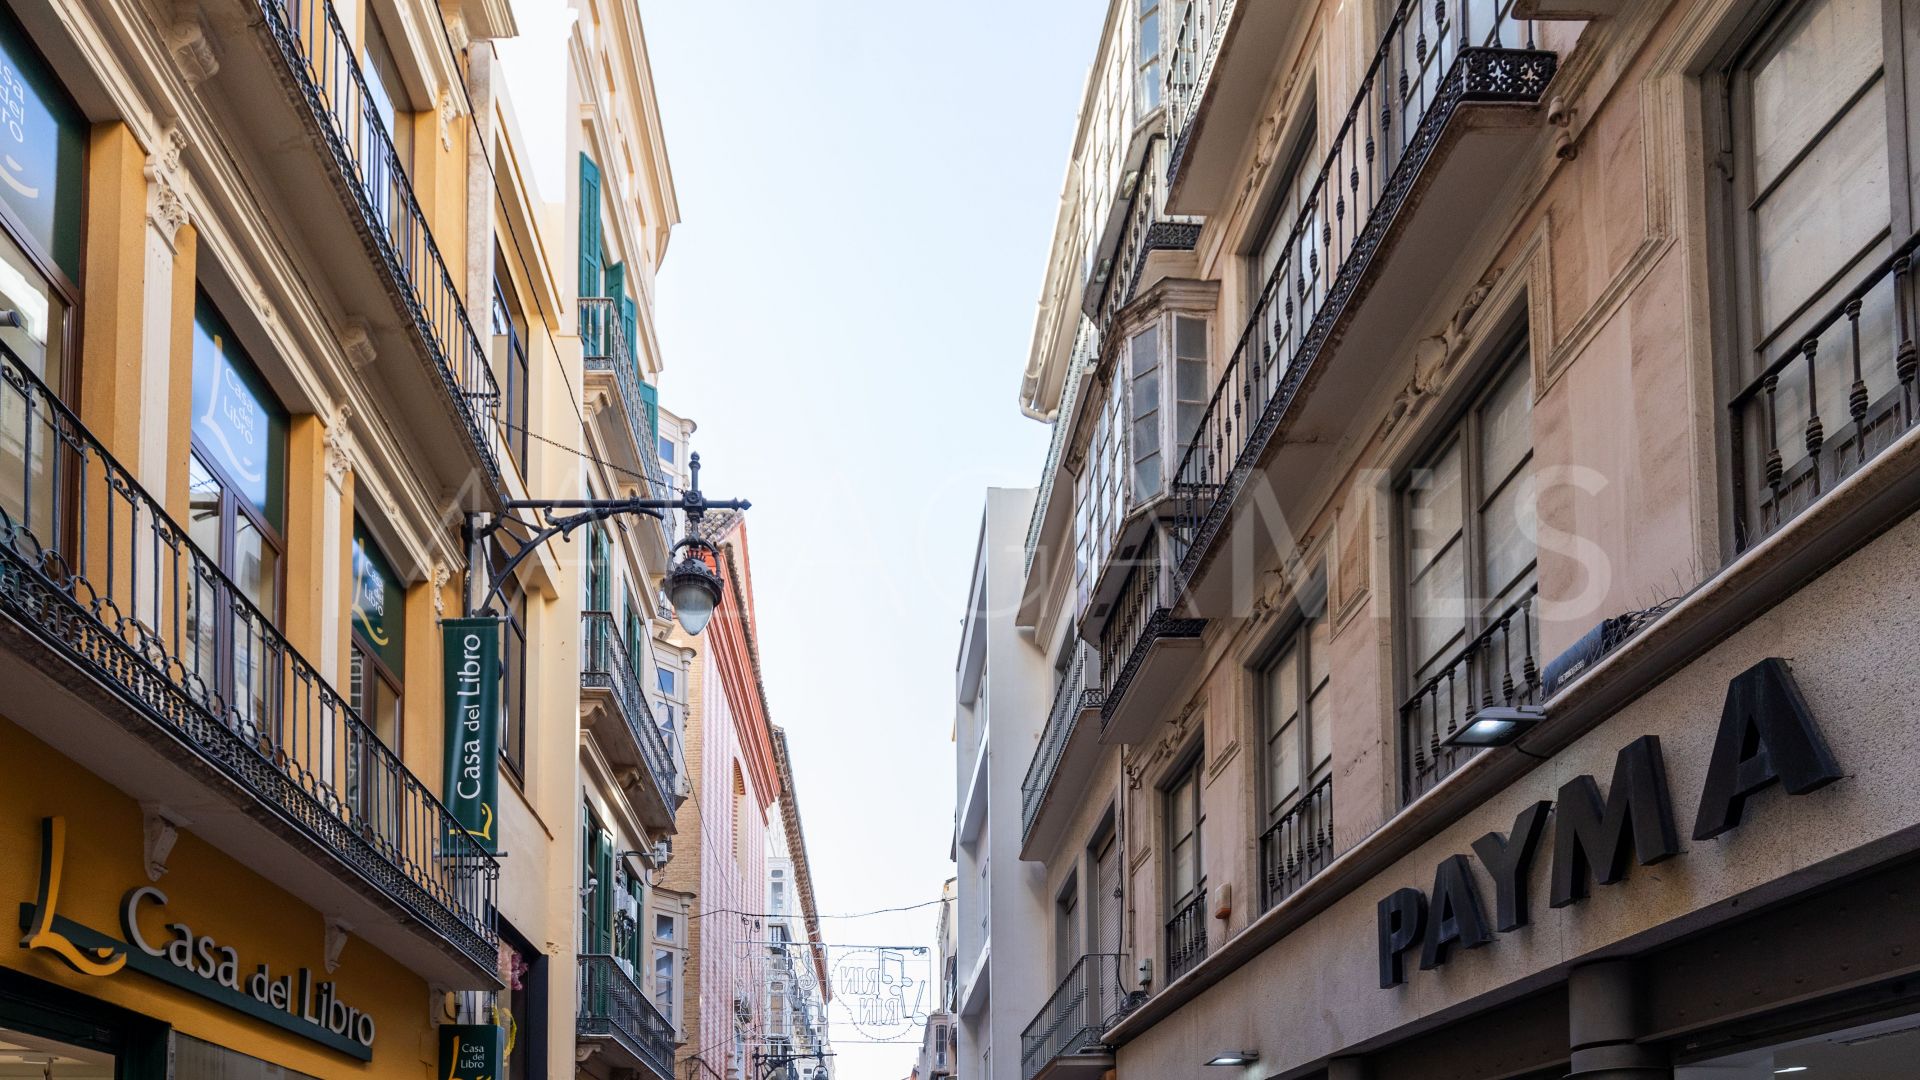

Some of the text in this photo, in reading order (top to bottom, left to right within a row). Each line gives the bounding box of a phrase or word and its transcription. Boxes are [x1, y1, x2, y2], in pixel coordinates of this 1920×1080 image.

[225, 367, 253, 416] Casa
[223, 395, 253, 445] Libro
[239, 406, 253, 433] del
[366, 561, 383, 592] Casa
[365, 583, 383, 616] Libro
[457, 634, 480, 696] Libro
[464, 704, 480, 731] del
[457, 739, 480, 799] Casa
[1378, 656, 1844, 990] PAYMA
[119, 886, 240, 991] Casa
[246, 964, 292, 1013] del
[299, 967, 375, 1047] Libro
[460, 1059, 484, 1069] Libro
[461, 1043, 484, 1053] Casa
[472, 1053, 484, 1061] del
